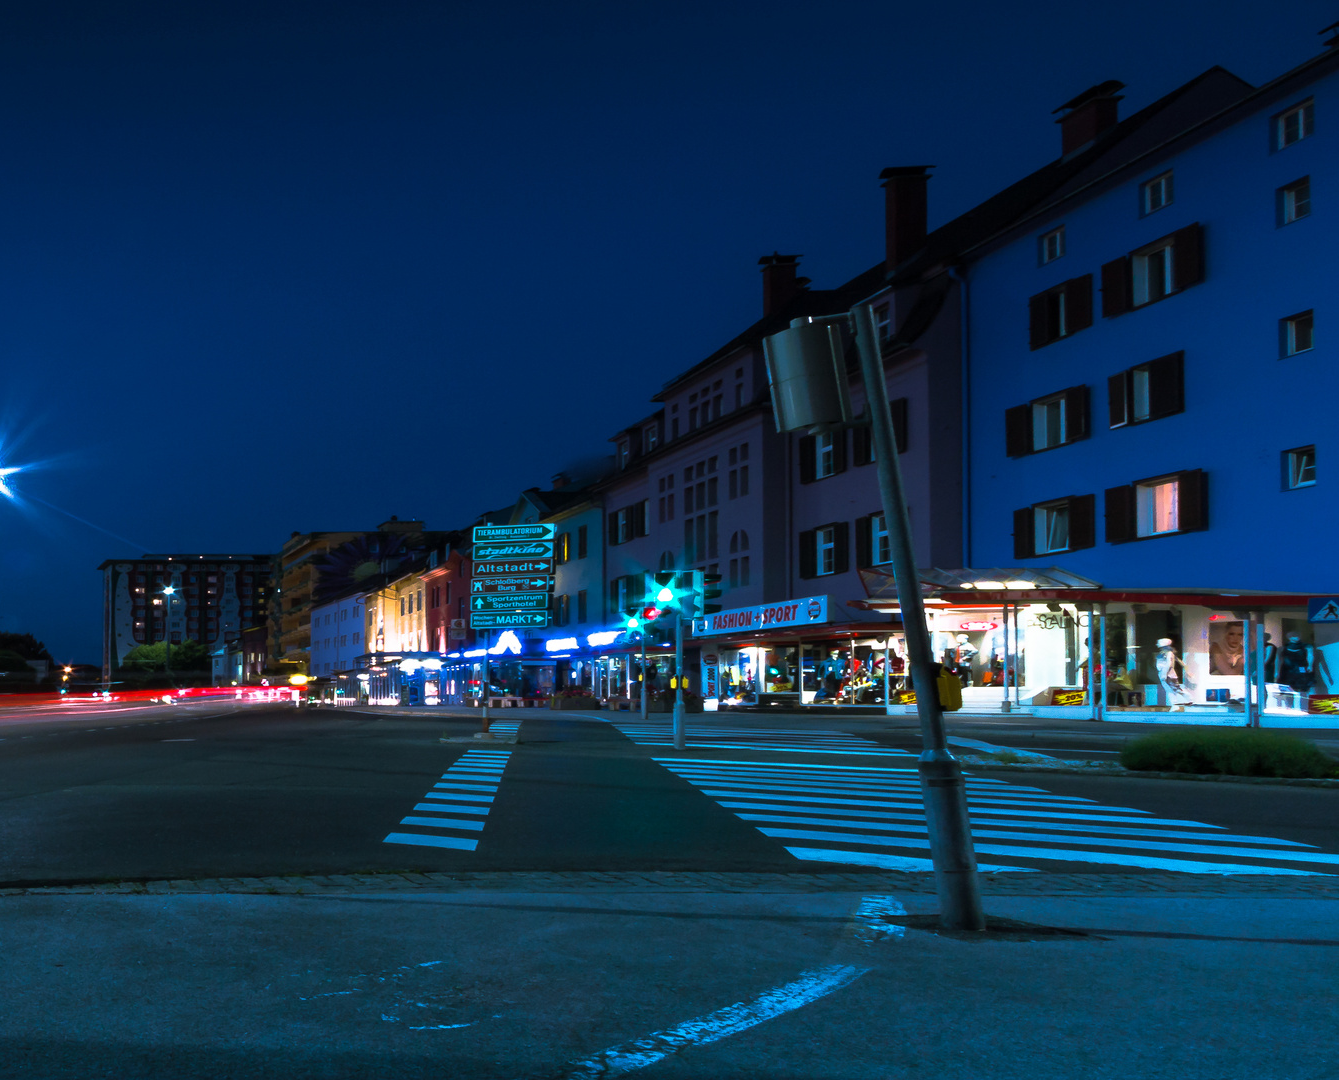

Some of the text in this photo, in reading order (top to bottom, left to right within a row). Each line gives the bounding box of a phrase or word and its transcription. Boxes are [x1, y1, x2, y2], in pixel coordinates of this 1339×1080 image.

[477, 527, 543, 536] TIERAMBULATORIUM
[477, 545, 545, 556] stadtkino
[476, 562, 534, 573] Altstadt
[487, 595, 543, 603] Sportzentrum
[496, 615, 533, 624] MARKT
[713, 611, 753, 630] FASHION
[762, 604, 799, 625] SPORT
